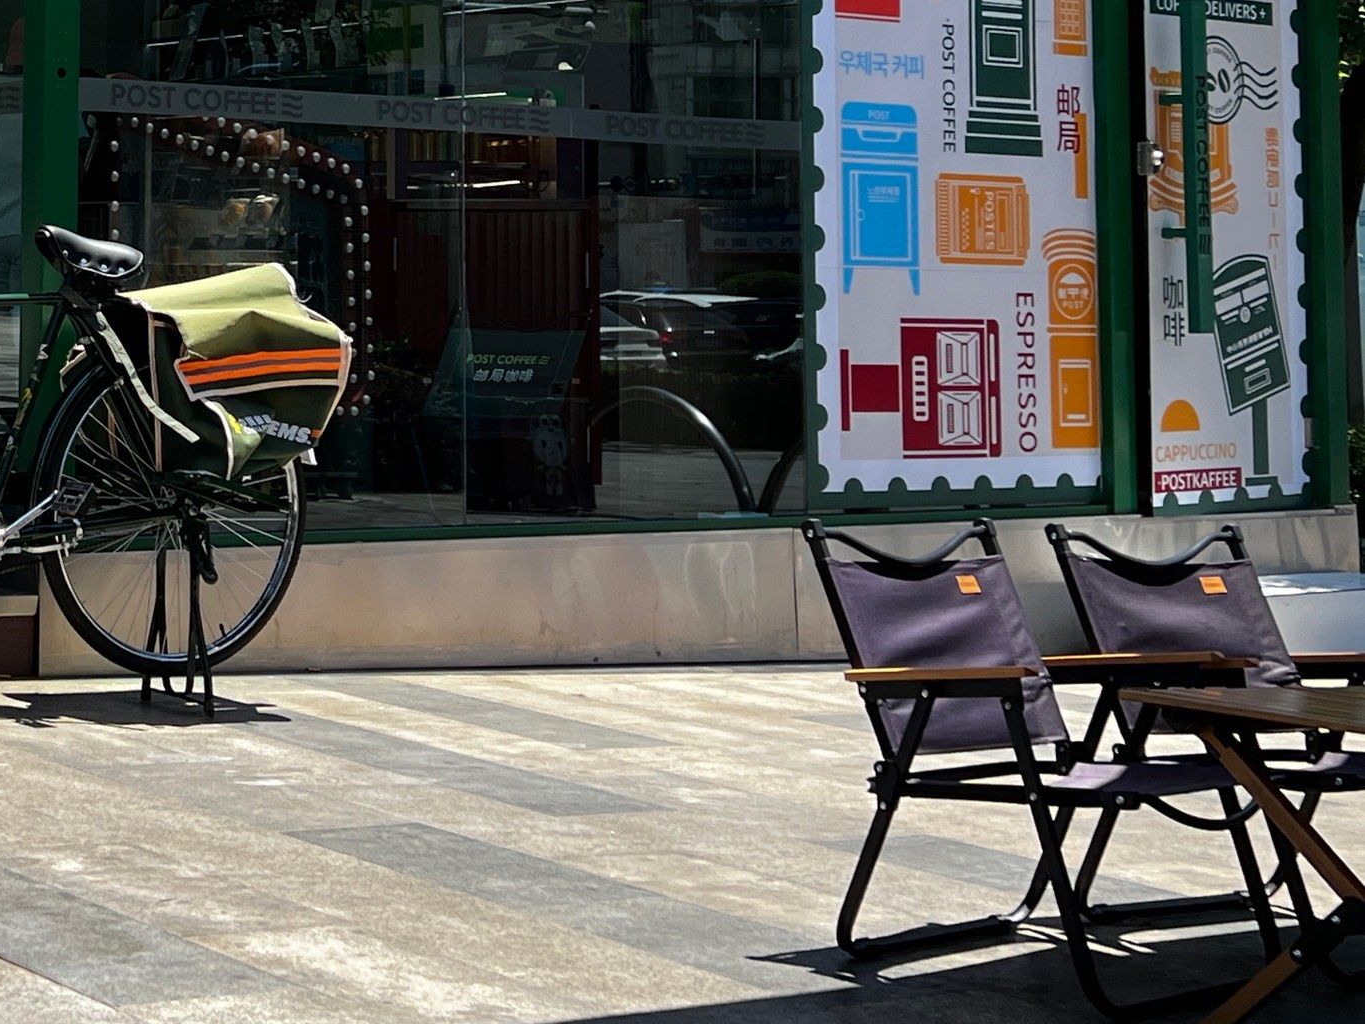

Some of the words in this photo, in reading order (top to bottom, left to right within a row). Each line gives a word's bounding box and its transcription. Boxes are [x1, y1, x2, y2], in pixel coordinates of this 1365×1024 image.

[838, 50, 890, 77] 우체국
[892, 54, 924, 80] 커피
[110, 83, 176, 110] POST
[185, 87, 277, 115] COFFEE
[376, 99, 436, 125] POST
[445, 101, 527, 131] COFFEE
[604, 114, 660, 137] POST
[665, 119, 745, 143] COFFEE
[942, 79, 956, 153] COFFEE
[1056, 83, 1081, 154] 邮局
[1195, 75, 1208, 135] POST
[1196, 140, 1210, 225] COFFEE
[985, 190, 996, 251] POSTES
[1162, 275, 1185, 347] 咖啡
[466, 354, 495, 365] POST
[1015, 292, 1038, 453] ESPRESSO
[1155, 442, 1237, 463] CAPPUCCINO
